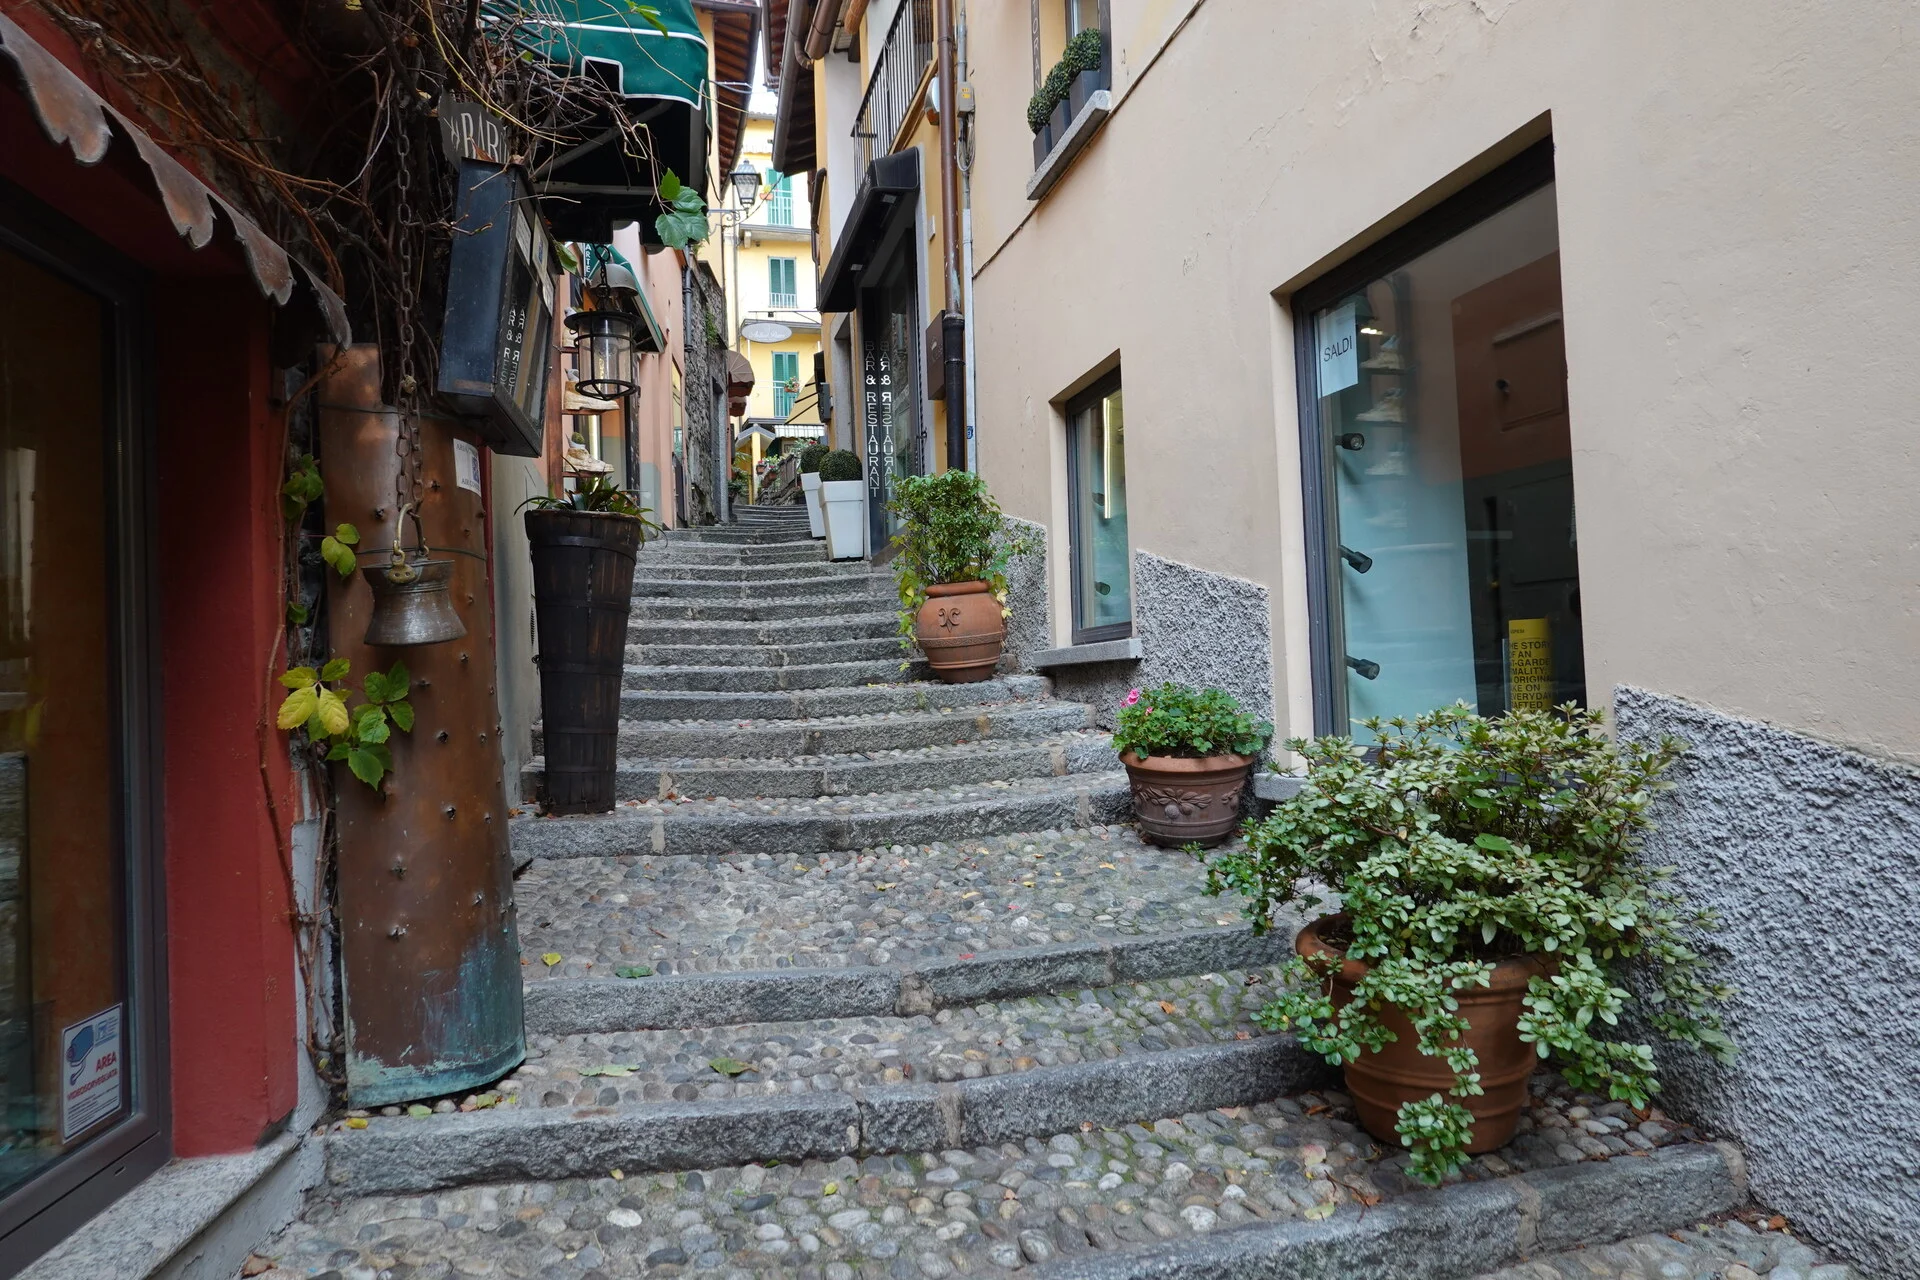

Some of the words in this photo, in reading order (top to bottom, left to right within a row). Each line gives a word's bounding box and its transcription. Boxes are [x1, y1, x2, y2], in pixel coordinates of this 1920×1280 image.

[864, 341, 876, 371] BAR
[1323, 335, 1353, 362] SALDI
[866, 374, 876, 385] &
[866, 391, 880, 497] RESTAURANT
[1517, 650, 1532, 658] AN
[1525, 684, 1541, 692] ON
[96, 1051, 117, 1073] AREA
